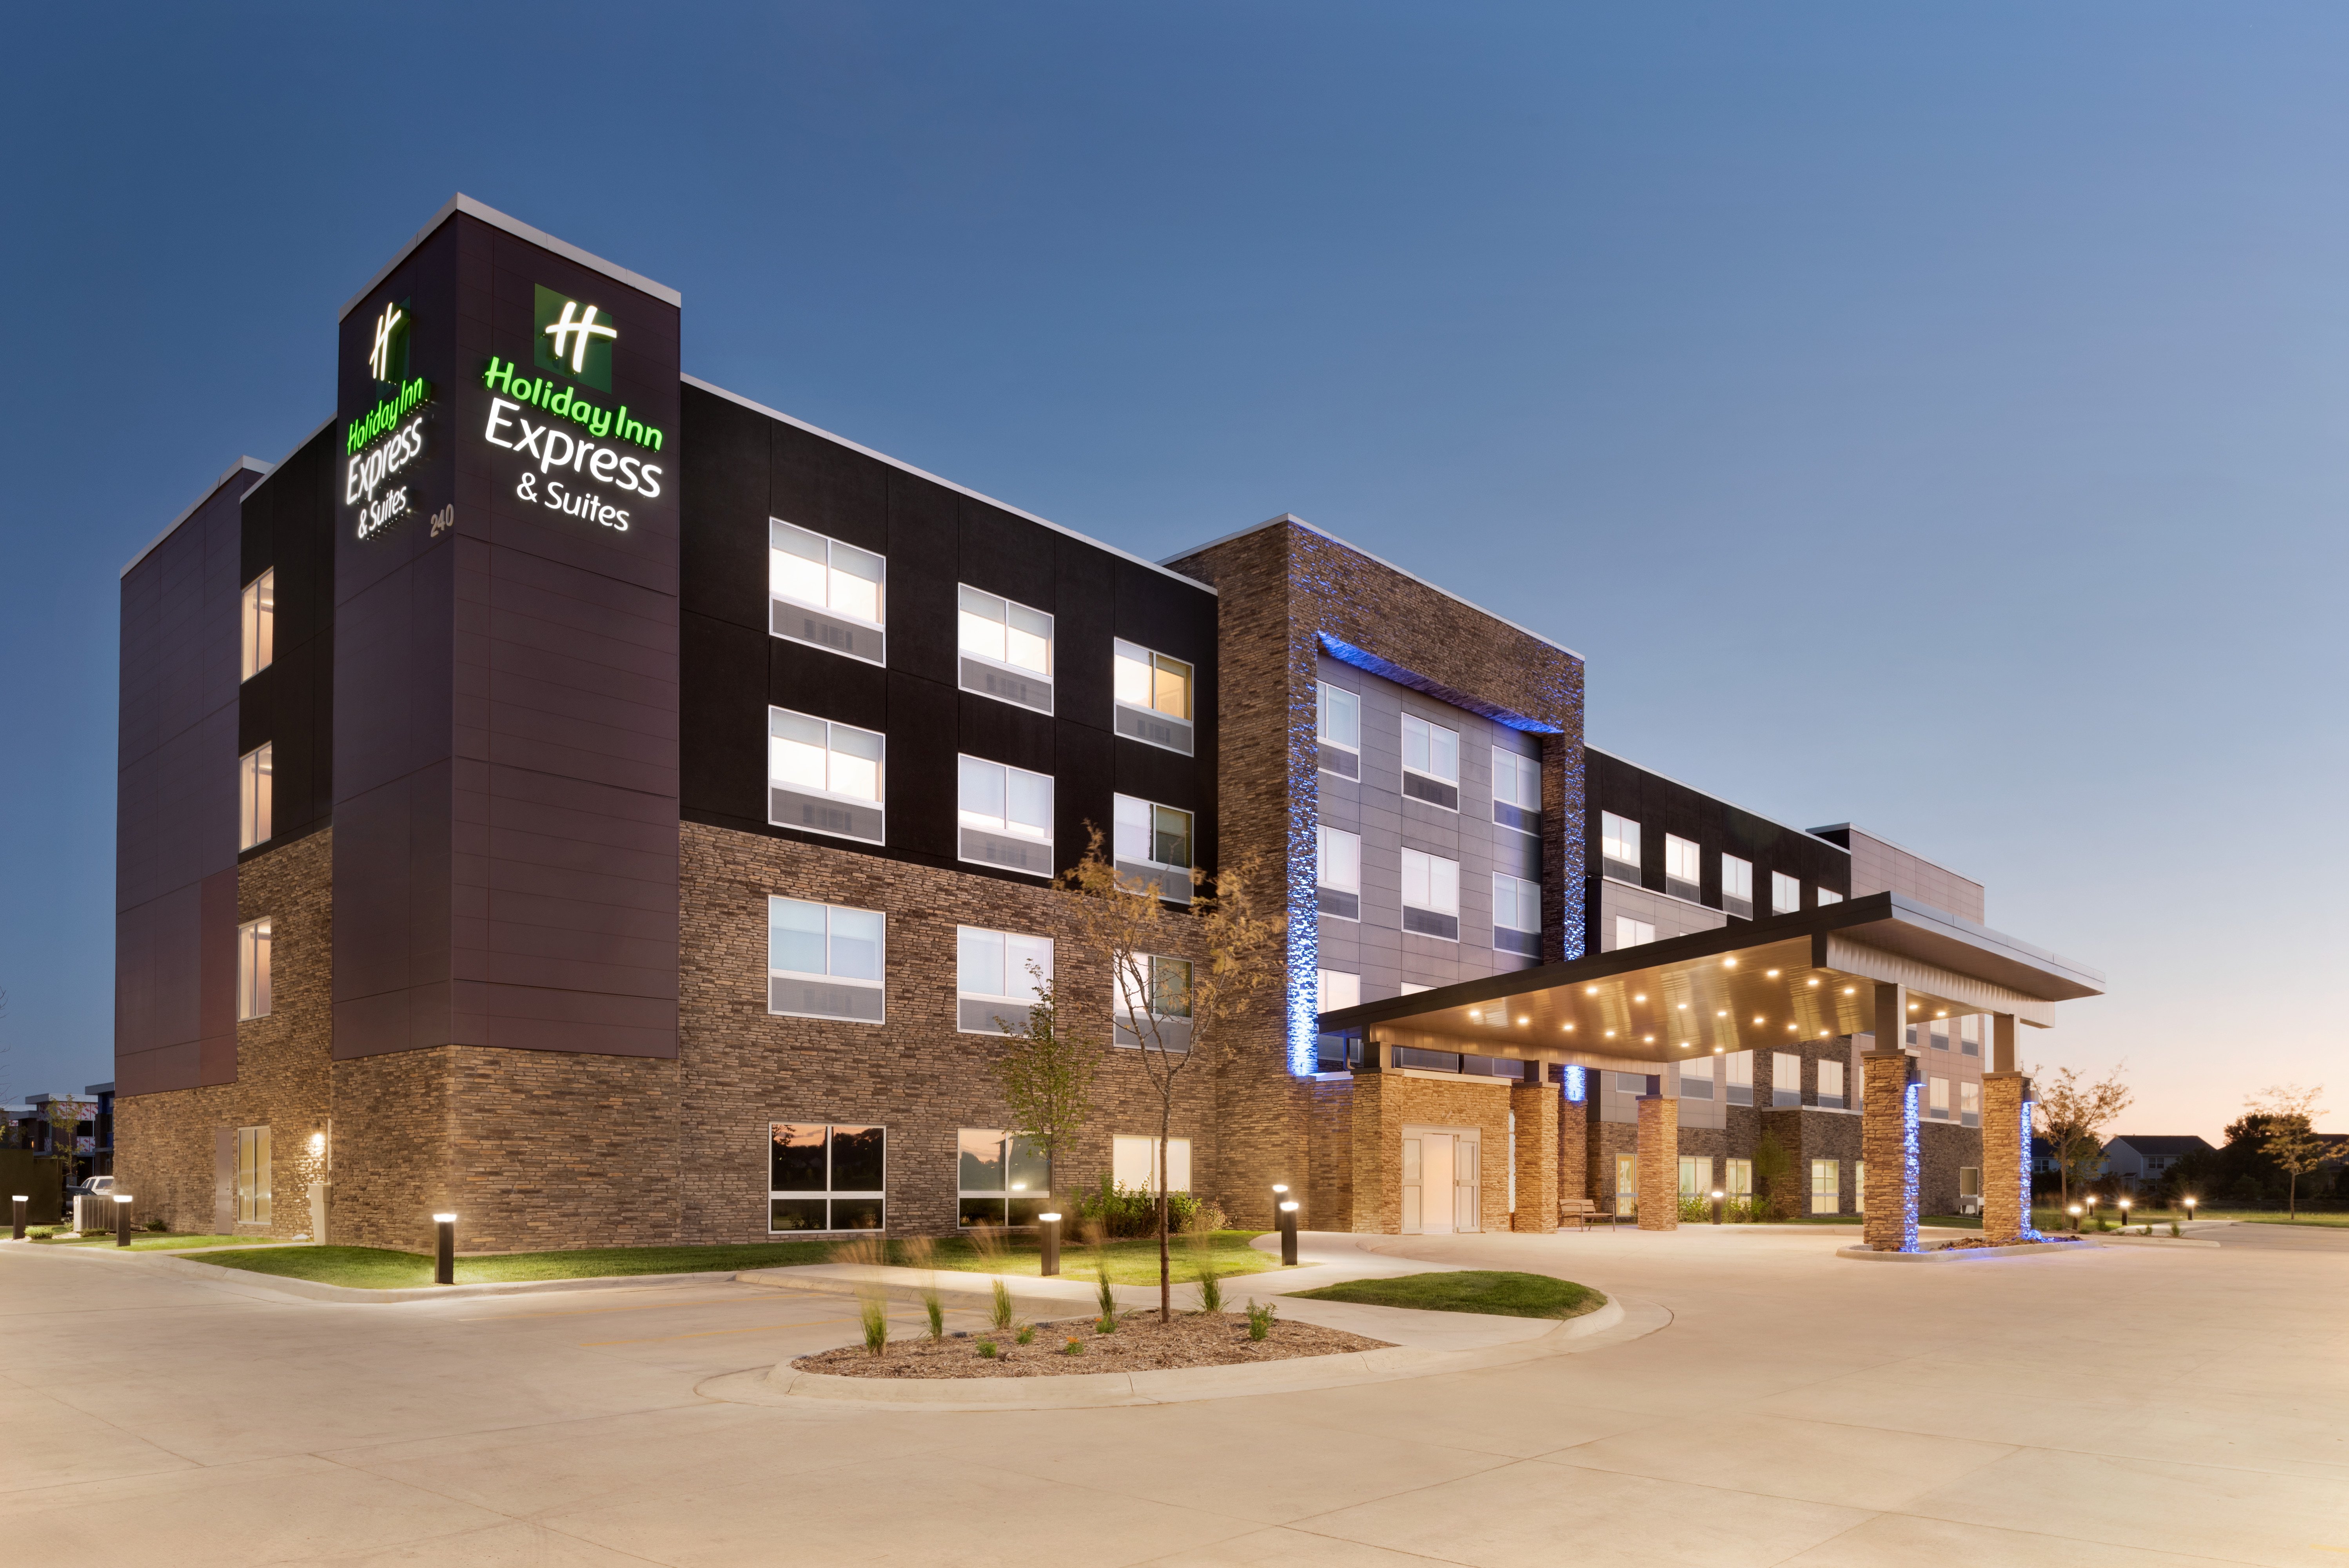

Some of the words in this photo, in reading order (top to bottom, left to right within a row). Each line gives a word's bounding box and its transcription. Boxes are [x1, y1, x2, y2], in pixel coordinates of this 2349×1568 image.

[347, 397, 399, 456] Holiday
[400, 377, 423, 414] Inn
[485, 356, 612, 437] Holiday
[616, 405, 663, 450] Inn
[346, 417, 422, 505] Express
[485, 397, 662, 498] Express
[358, 509, 367, 539] &
[369, 486, 407, 531] Suites
[430, 504, 454, 537] 240
[517, 472, 537, 503] &
[544, 482, 630, 531] Suites
